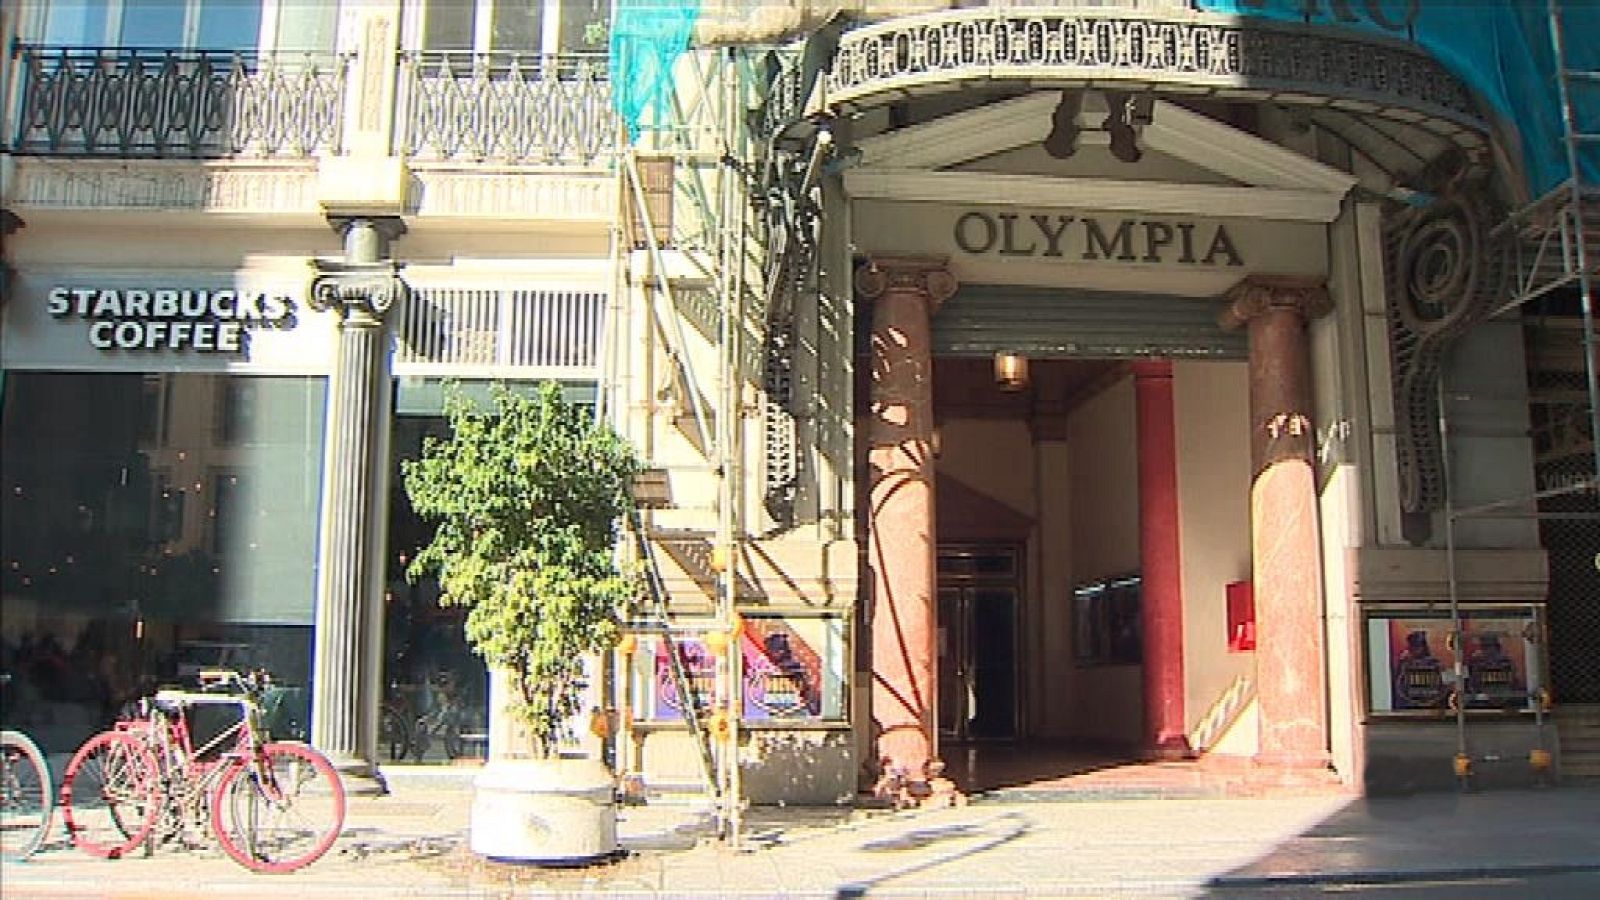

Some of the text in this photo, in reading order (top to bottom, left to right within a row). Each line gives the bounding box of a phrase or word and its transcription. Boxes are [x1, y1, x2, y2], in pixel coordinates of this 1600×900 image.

[954, 212, 1244, 266] OLYMPIA
[48, 286, 288, 319] STARBUCKS
[88, 320, 241, 351] COFFEE
